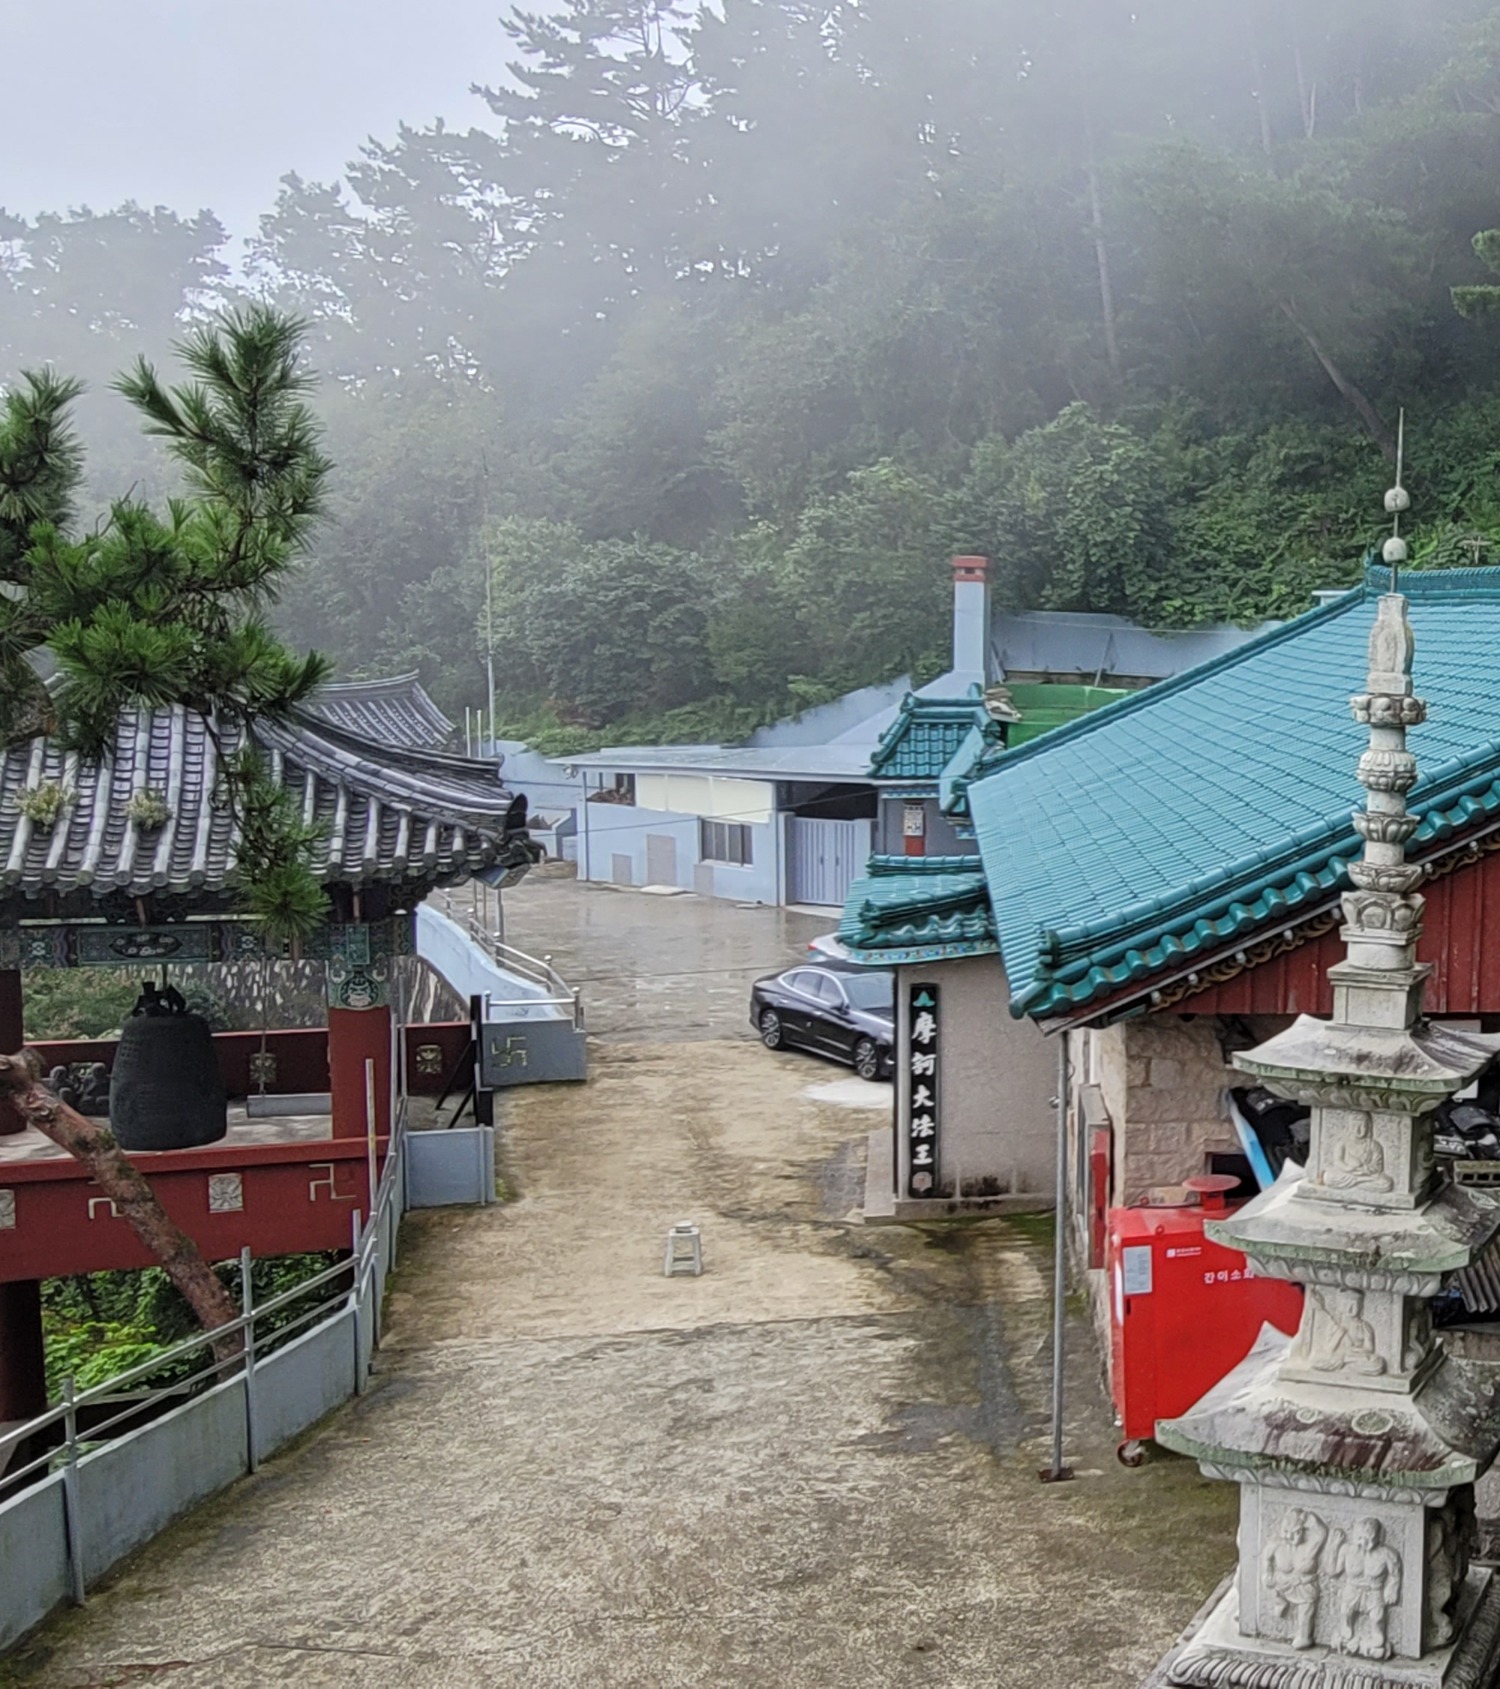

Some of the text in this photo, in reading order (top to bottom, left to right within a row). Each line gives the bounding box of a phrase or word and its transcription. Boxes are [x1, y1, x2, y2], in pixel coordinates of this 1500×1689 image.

[911, 1011, 937, 1165] 摩訶大法王
